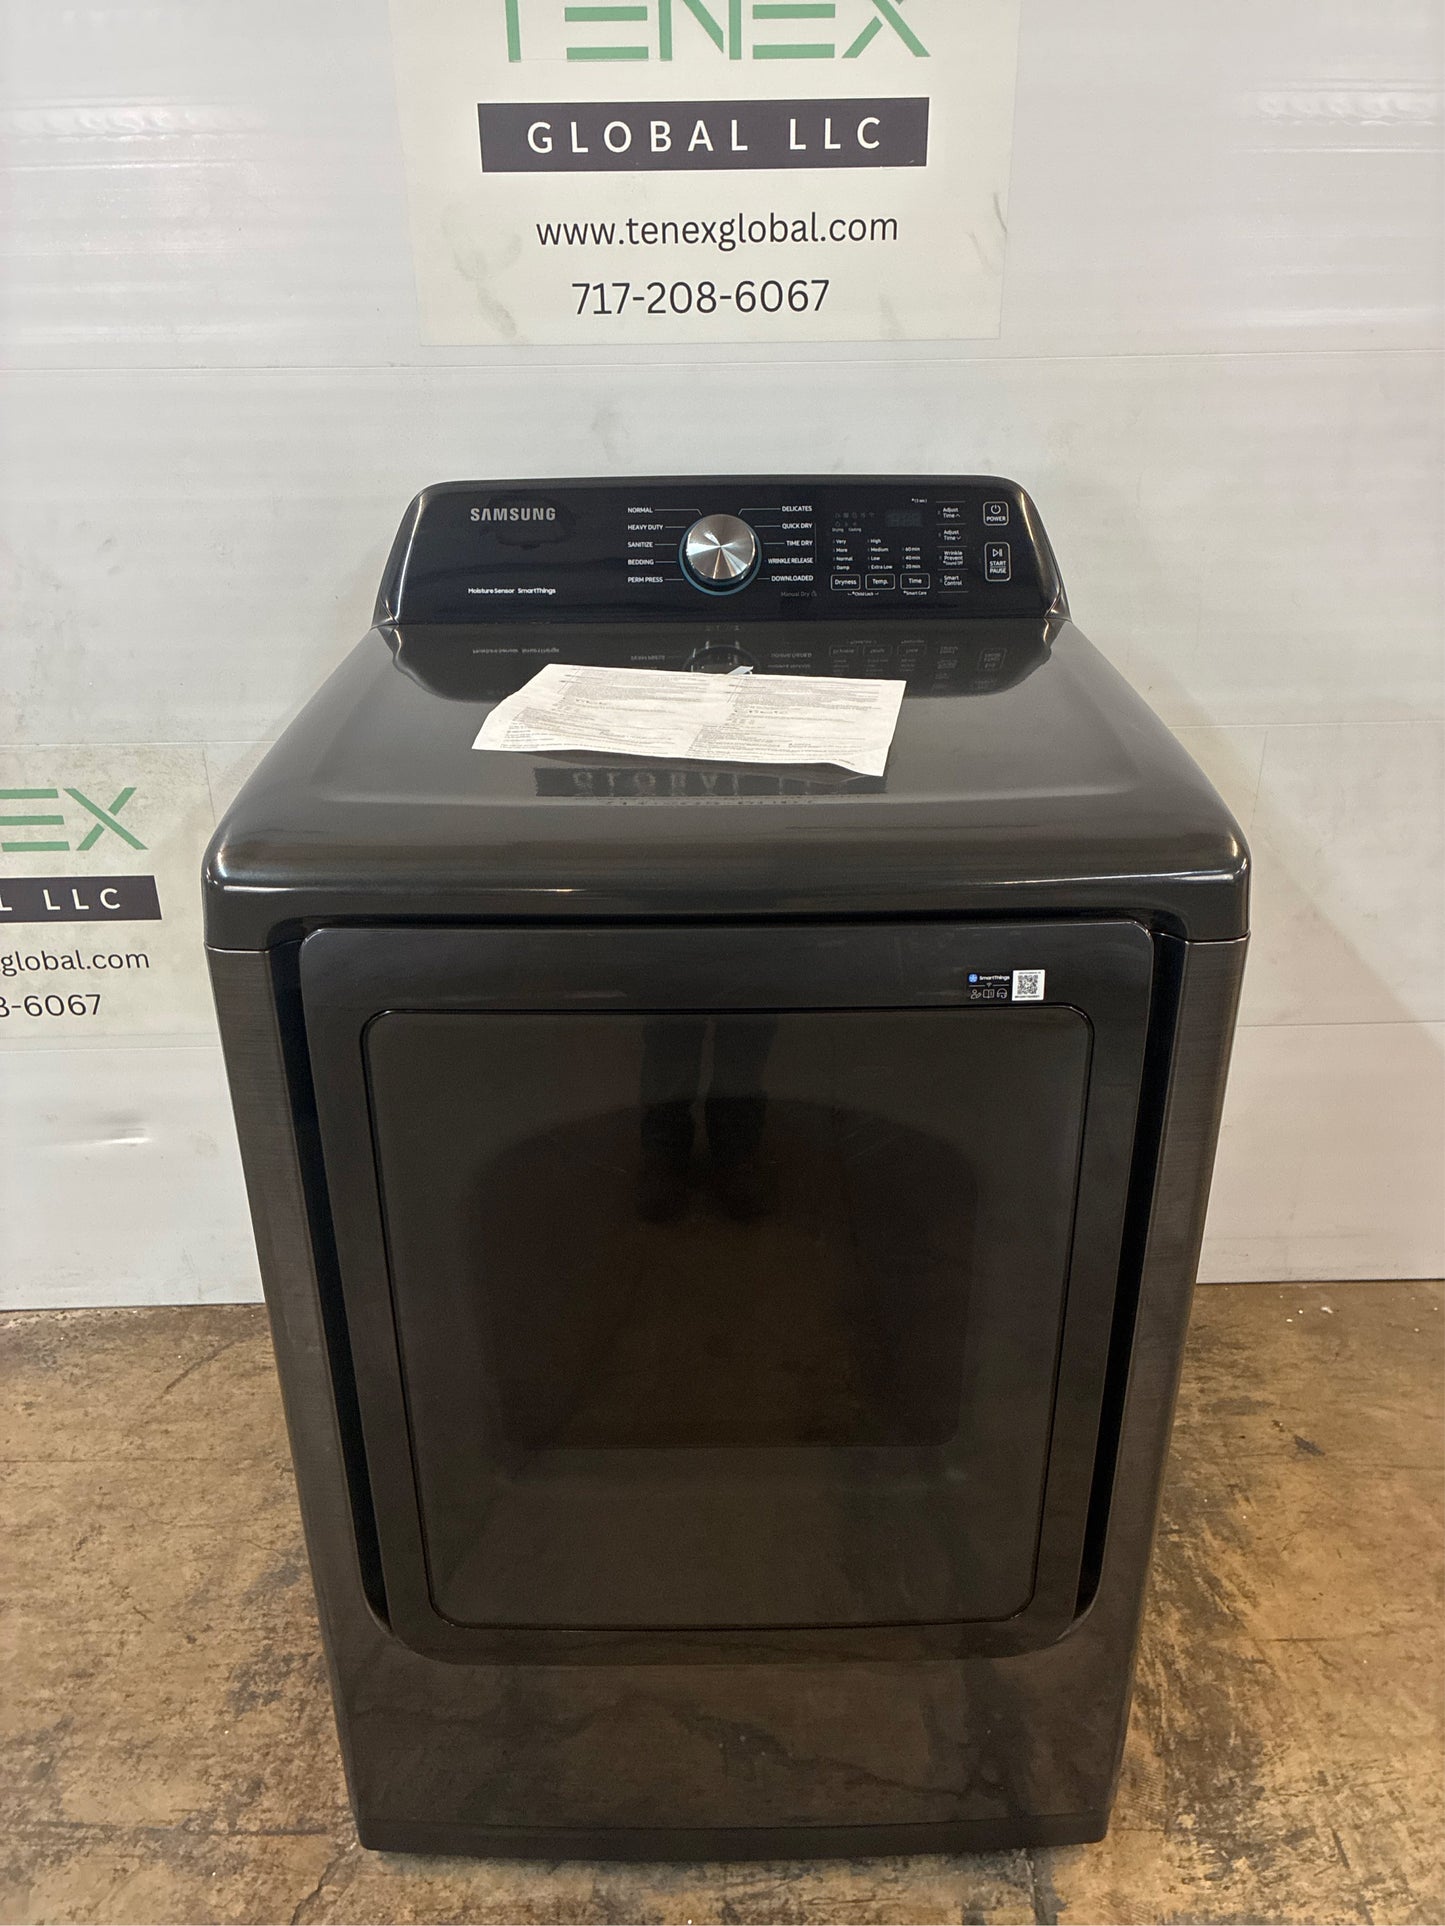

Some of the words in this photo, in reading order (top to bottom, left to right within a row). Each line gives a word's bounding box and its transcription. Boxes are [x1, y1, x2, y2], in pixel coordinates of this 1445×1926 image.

[527, 119, 748, 154] GLOBAL
[789, 116, 881, 151] LLC
[536, 212, 899, 252] www.tenexglobal.com
[571, 279, 831, 315] 717-208-6067
[470, 507, 556, 522] SAMSUNG
[517, 587, 556, 596] SmartThings
[872, 578, 889, 586] Temp.
[43, 887, 122, 912] LLC
